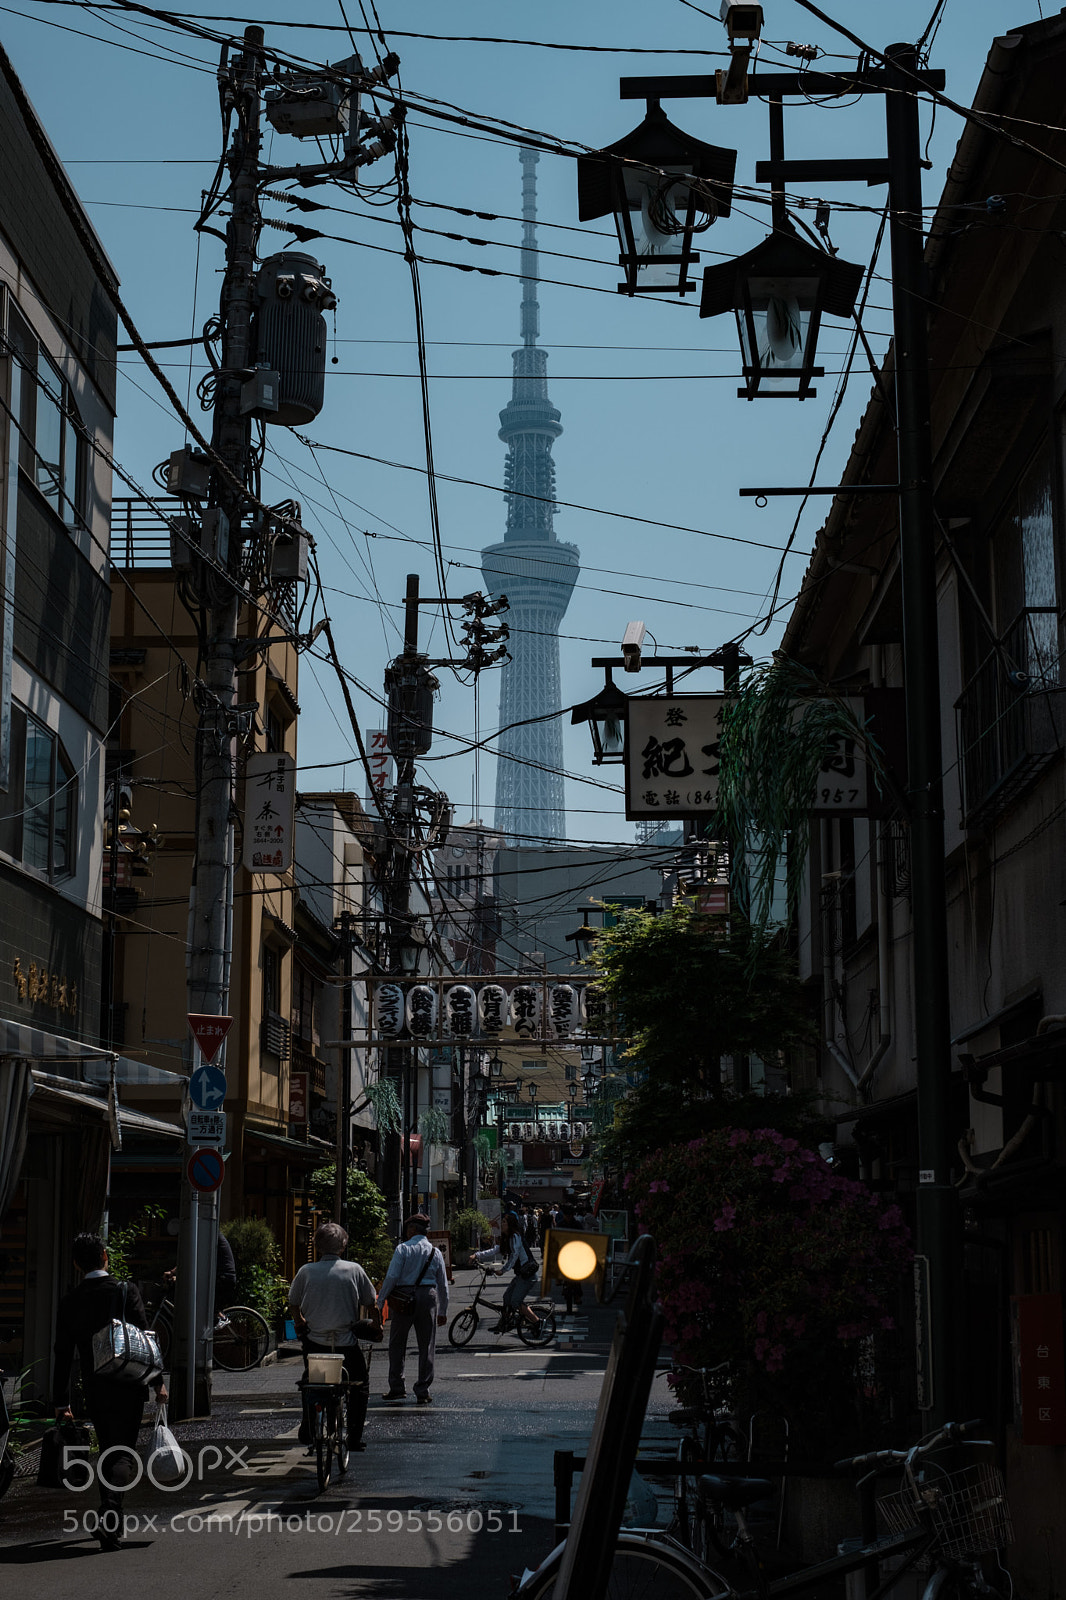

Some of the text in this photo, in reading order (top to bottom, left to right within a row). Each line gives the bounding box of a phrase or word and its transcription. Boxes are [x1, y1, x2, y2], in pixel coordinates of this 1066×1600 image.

[642, 790, 680, 806] 電話
[196, 1024, 224, 1037] 止まれ
[191, 1114, 223, 1125] 自転車を除く
[191, 1125, 223, 1136] 一方通行
[1036, 1344, 1051, 1422] 台東区
